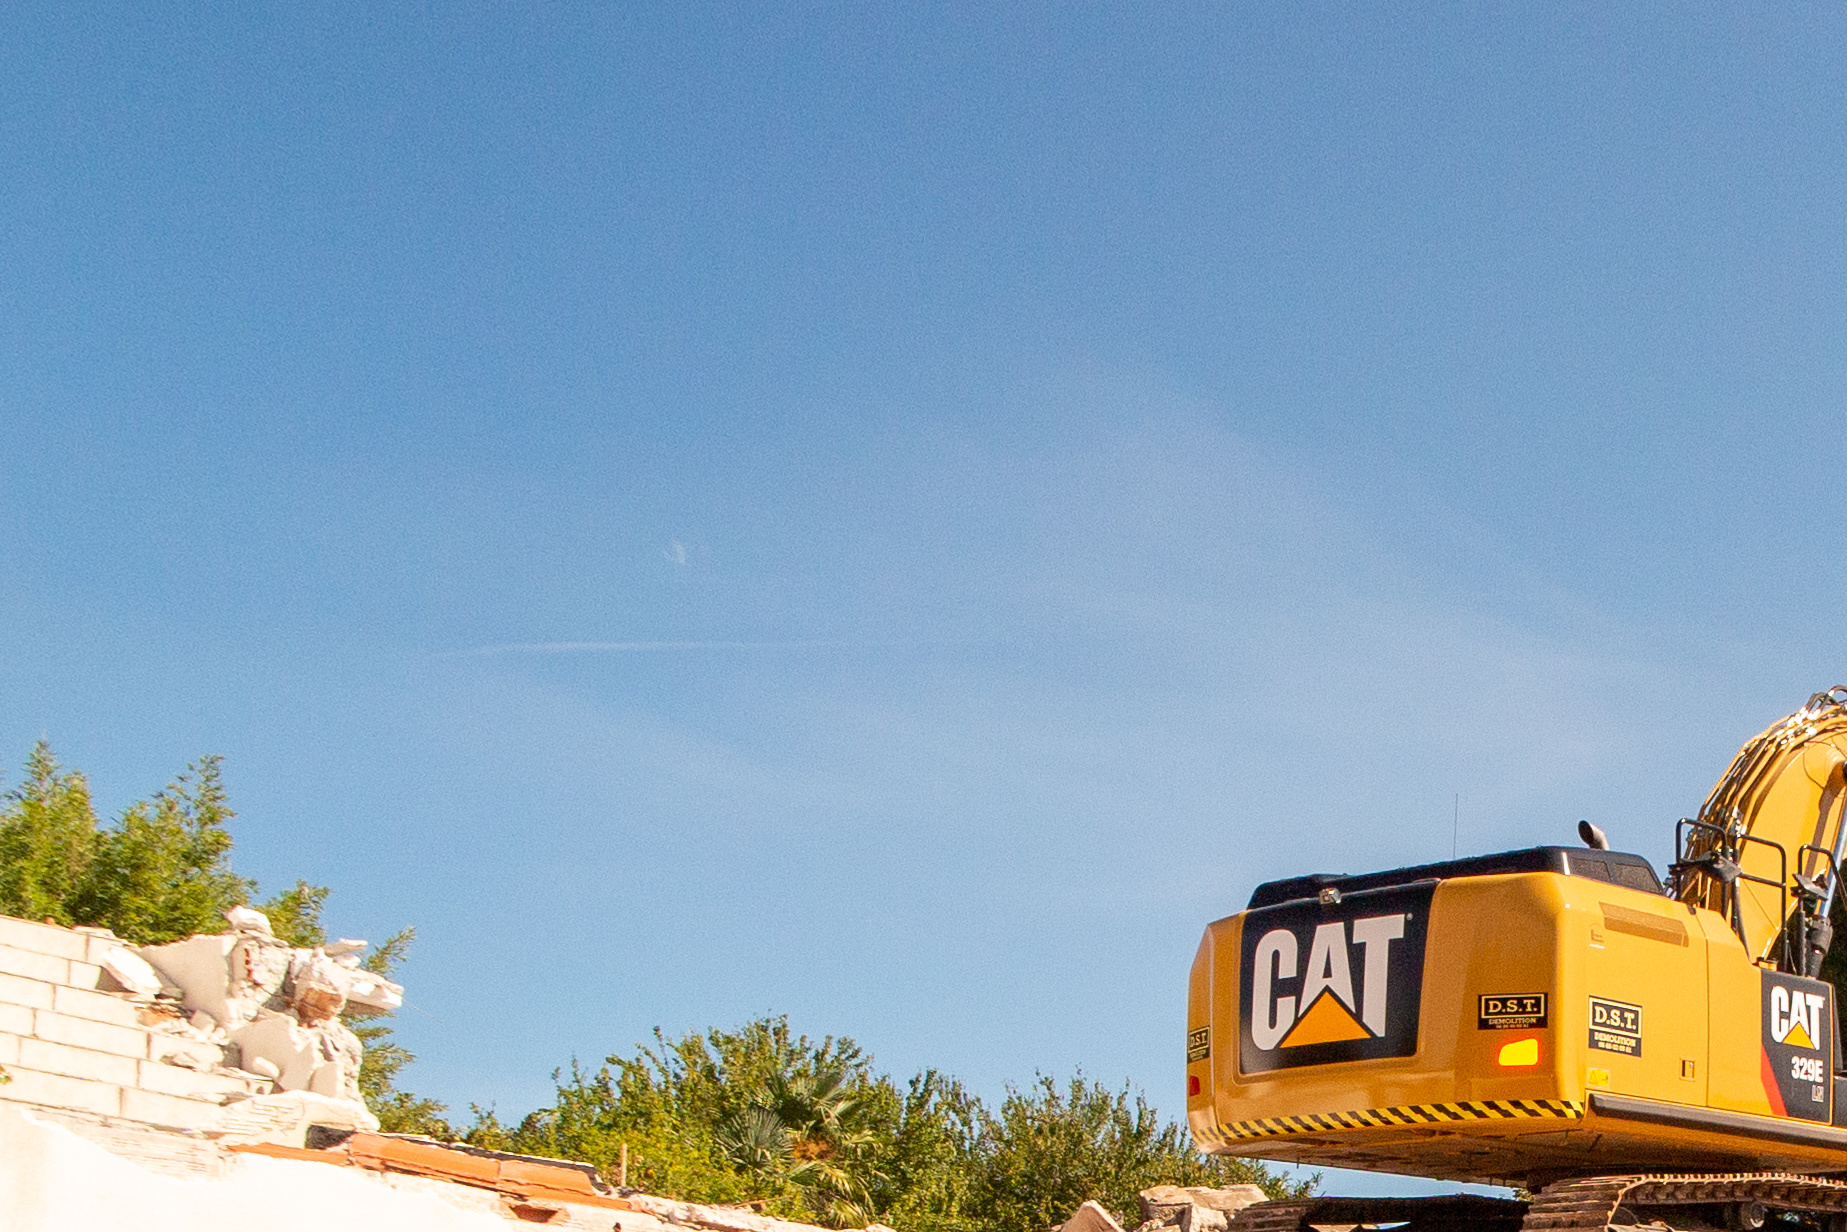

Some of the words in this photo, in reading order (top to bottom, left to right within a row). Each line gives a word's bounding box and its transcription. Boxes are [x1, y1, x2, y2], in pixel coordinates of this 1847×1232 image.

[1252, 914, 1405, 1050] CAT
[1488, 1000, 1537, 1012] D.S.T.
[1594, 1006, 1636, 1029] D.S.T.
[1771, 986, 1825, 1050] CAT
[1594, 1032, 1636, 1047] DEMOLITION
[1791, 1055, 1824, 1083] 329E
